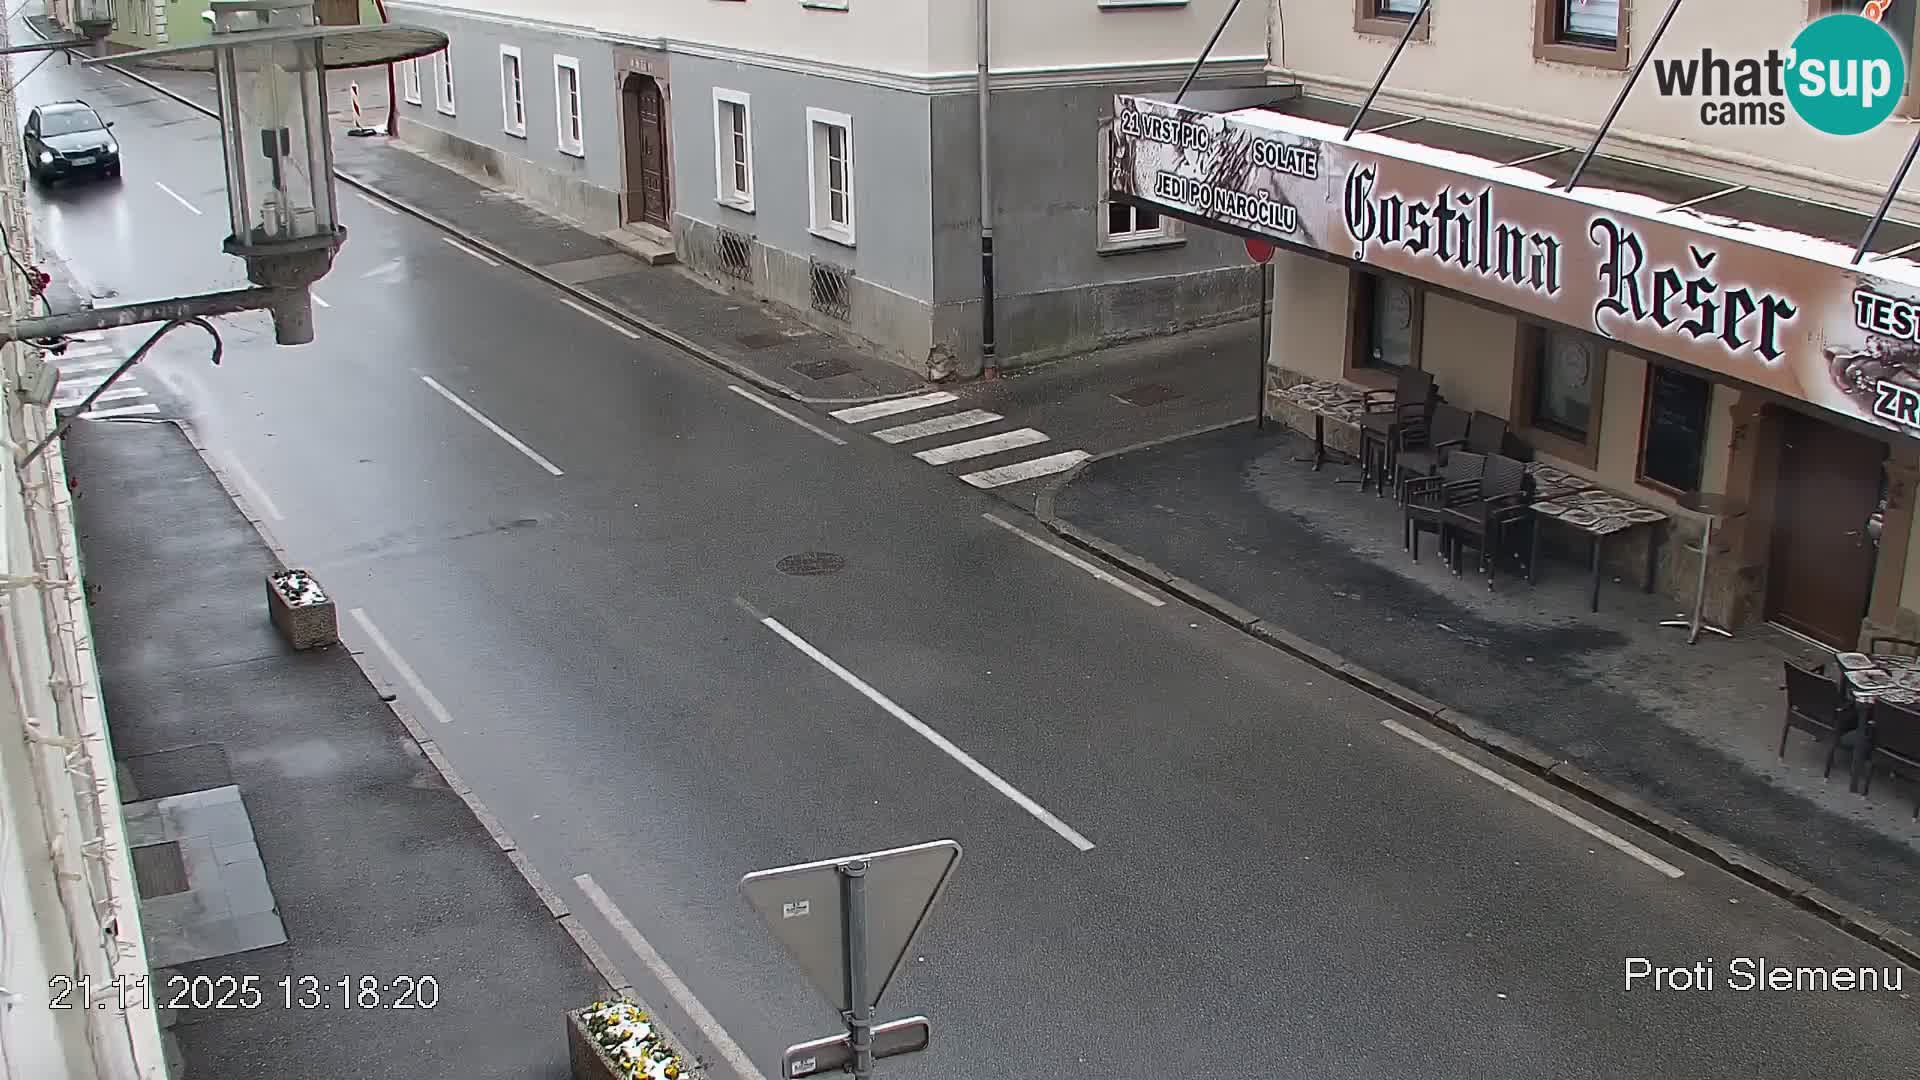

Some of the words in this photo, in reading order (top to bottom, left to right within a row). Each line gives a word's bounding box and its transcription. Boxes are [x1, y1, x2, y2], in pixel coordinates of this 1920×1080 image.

[1122, 110, 1140, 135] 21
[1142, 114, 1180, 145] VRST
[1182, 122, 1209, 151] PIC
[1253, 138, 1318, 178] SOLATE
[1154, 172, 1187, 202] JEDI
[1189, 180, 1212, 209] PO
[1214, 188, 1297, 233] NAROČILU
[1344, 162, 1561, 295] Gostilna
[1589, 217, 1797, 362] Rešer
[1873, 379, 1920, 428] ZR
